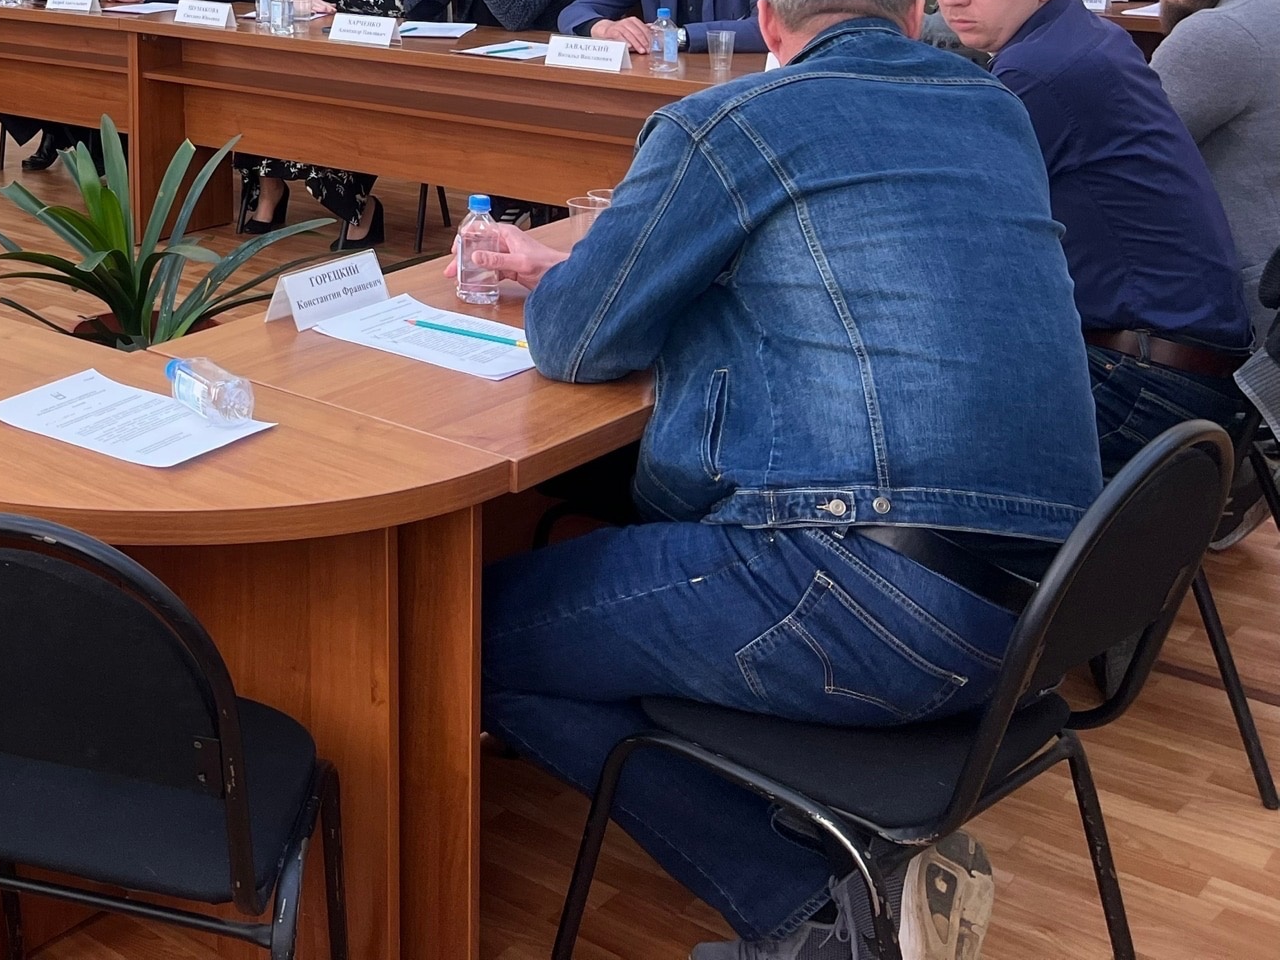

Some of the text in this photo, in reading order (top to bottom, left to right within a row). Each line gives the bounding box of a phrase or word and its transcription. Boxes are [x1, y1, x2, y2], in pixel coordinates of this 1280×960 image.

[348, 19, 381, 27] ХАРЧЕНКО
[565, 42, 609, 52] ЗАВАДСКИЙ
[309, 262, 360, 288] ГОРЕЦКИЙ
[296, 278, 382, 310] Константин Францевич
